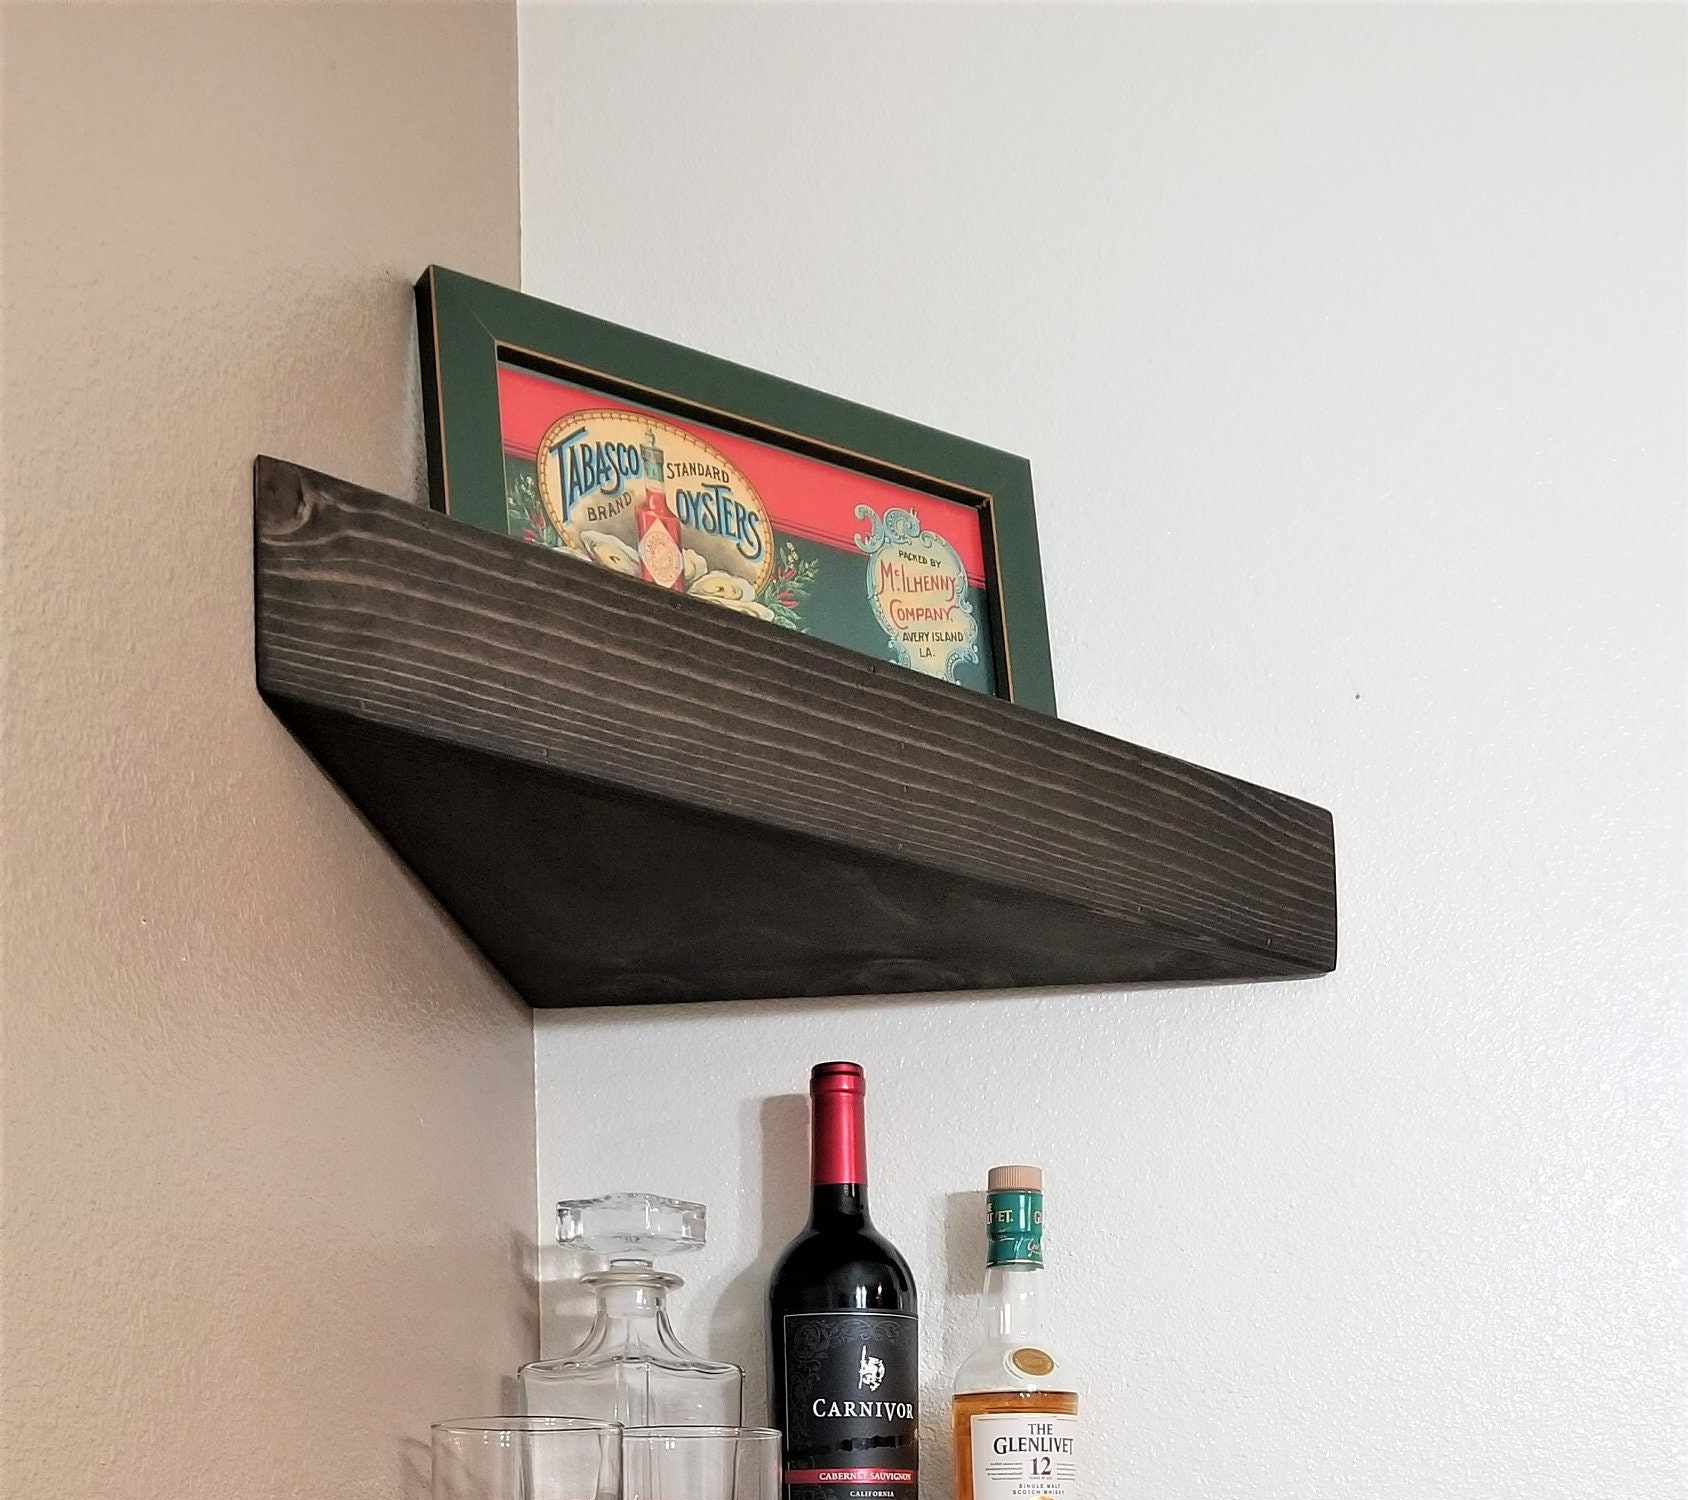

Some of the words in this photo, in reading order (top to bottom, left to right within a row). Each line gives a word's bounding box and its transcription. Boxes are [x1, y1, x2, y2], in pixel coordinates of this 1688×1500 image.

[549, 425, 643, 524] TABASCO
[666, 462, 730, 484] STANDARD
[586, 491, 632, 522] BRAND
[675, 482, 763, 562] OYSTERS
[898, 549, 928, 564] PACKED
[930, 558, 942, 568] BY
[902, 631, 930, 642] AVERY
[932, 631, 964, 642] ISLAND
[812, 1398, 914, 1422] CARNIVOR
[1027, 1423, 1054, 1435] THE
[993, 1436, 1074, 1455] GLENLIVET
[1029, 1456, 1052, 1475] 12
[819, 1471, 868, 1481] CABERNET
[849, 1490, 895, 1498] CALIFORNIA
